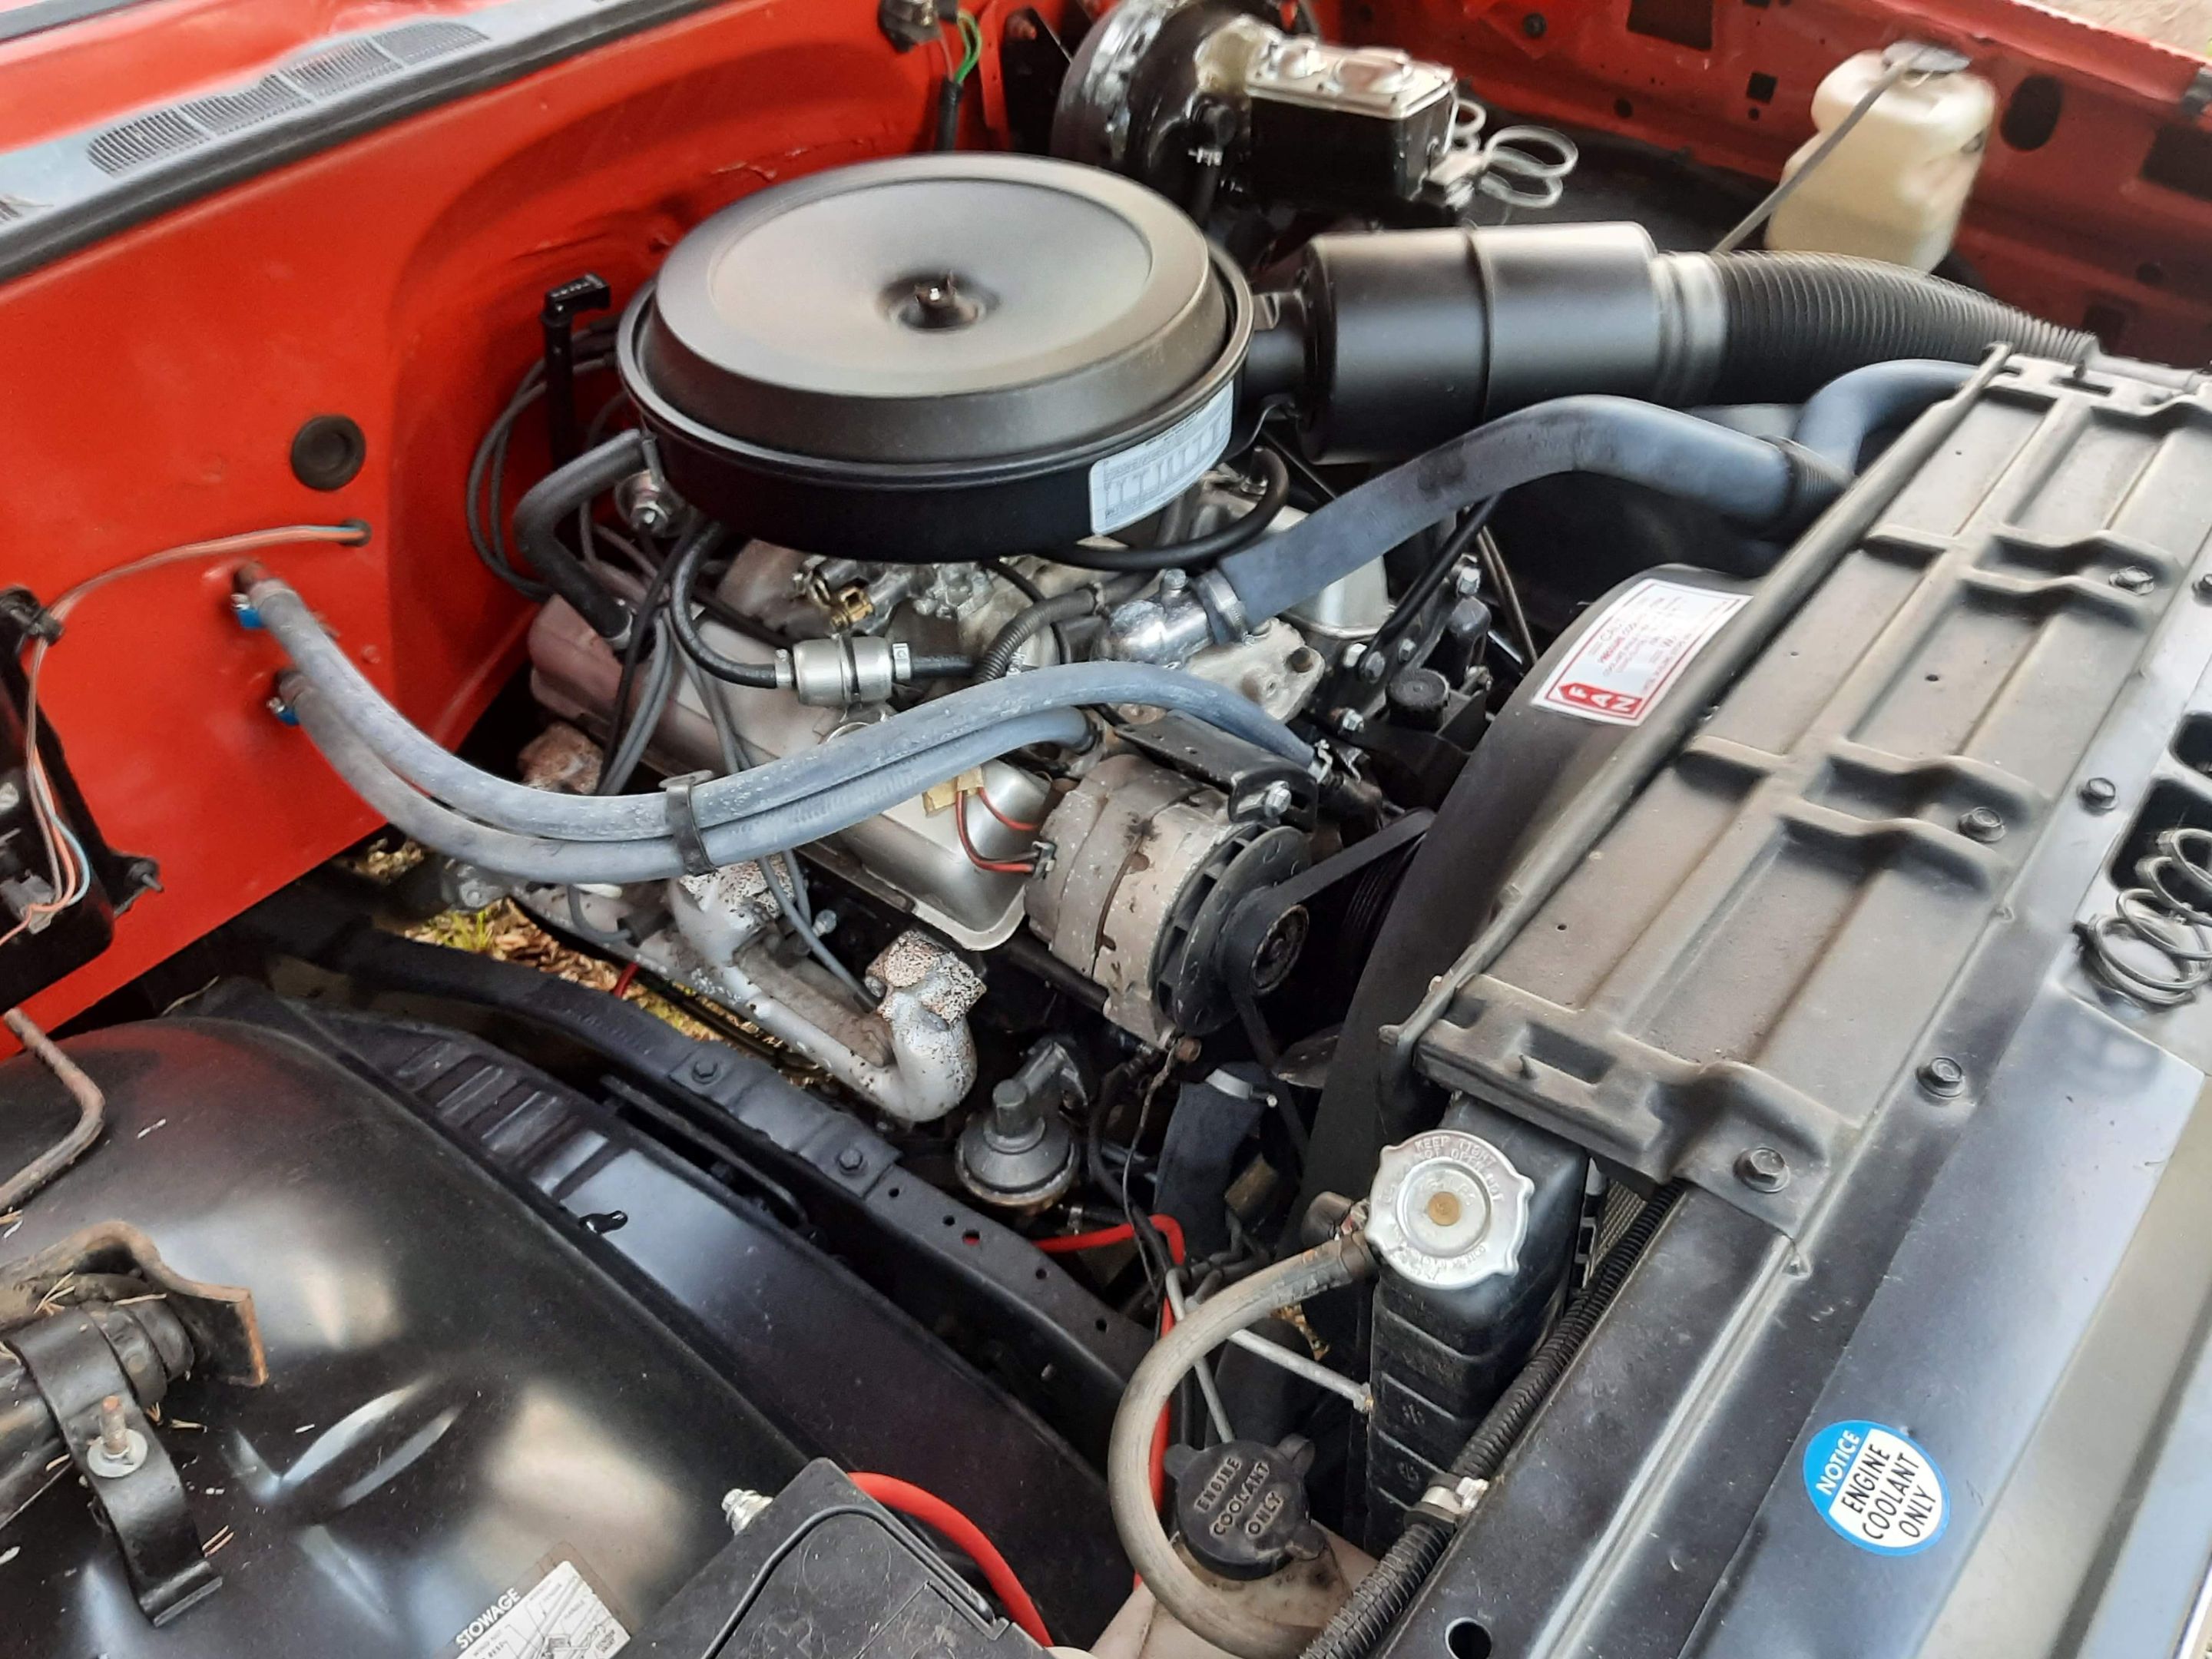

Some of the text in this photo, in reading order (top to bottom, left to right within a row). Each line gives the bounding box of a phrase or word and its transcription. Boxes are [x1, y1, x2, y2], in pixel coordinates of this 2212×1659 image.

[1568, 686, 1635, 712] FAN
[1414, 1135, 1497, 1167] KEEP TIGHT
[1194, 1456, 1241, 1512] ENGINE
[1815, 1429, 1861, 1496] NOTICE
[1840, 1443, 1891, 1515] ENGINE
[1210, 1462, 1270, 1536] COOLANT
[1245, 1491, 1283, 1539] ONLY
[1862, 1452, 1919, 1540] COOLANT
[1898, 1484, 1936, 1538] ONLY
[455, 1587, 522, 1649] STOWAGE
